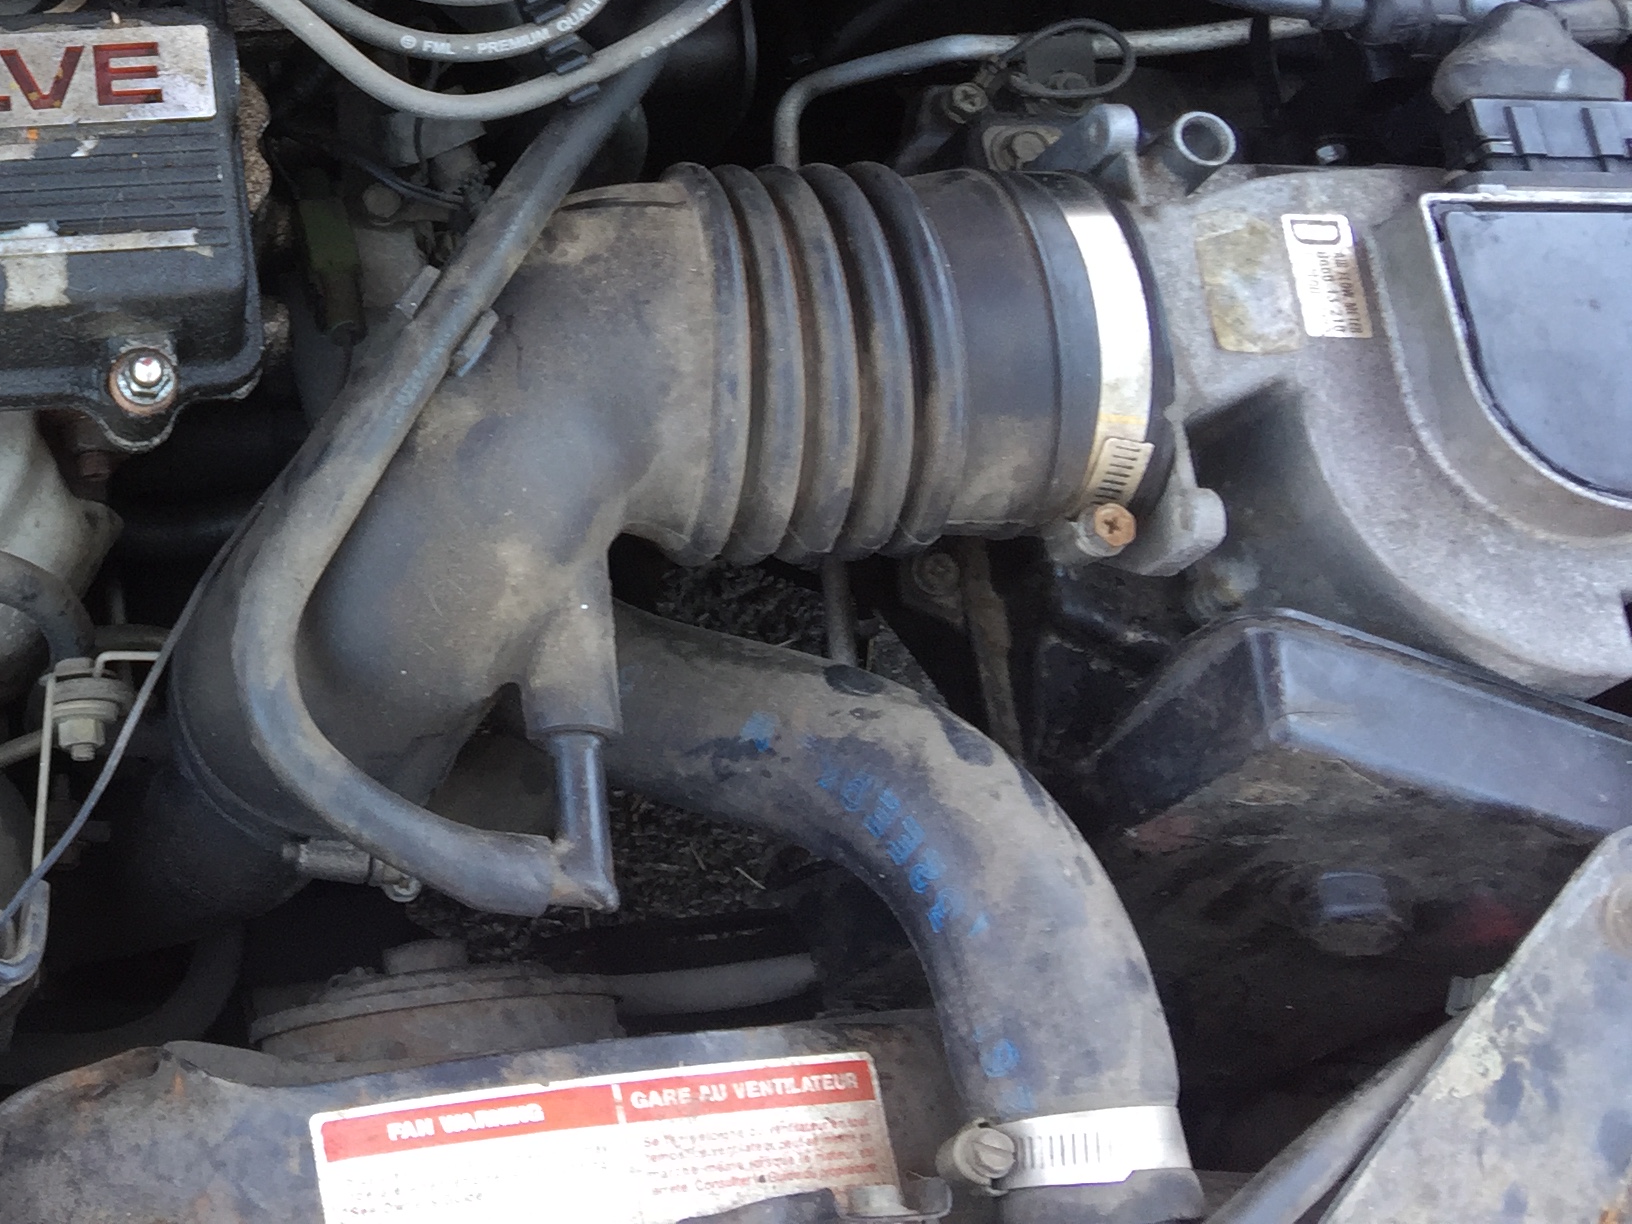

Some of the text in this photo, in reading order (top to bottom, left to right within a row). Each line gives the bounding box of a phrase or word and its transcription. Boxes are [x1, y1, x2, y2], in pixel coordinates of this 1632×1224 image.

[477, 27, 551, 54] PREMIUM
[630, 1072, 859, 1108] GARE AU VENTILATEUR
[386, 1103, 545, 1141] FAN WARNING
